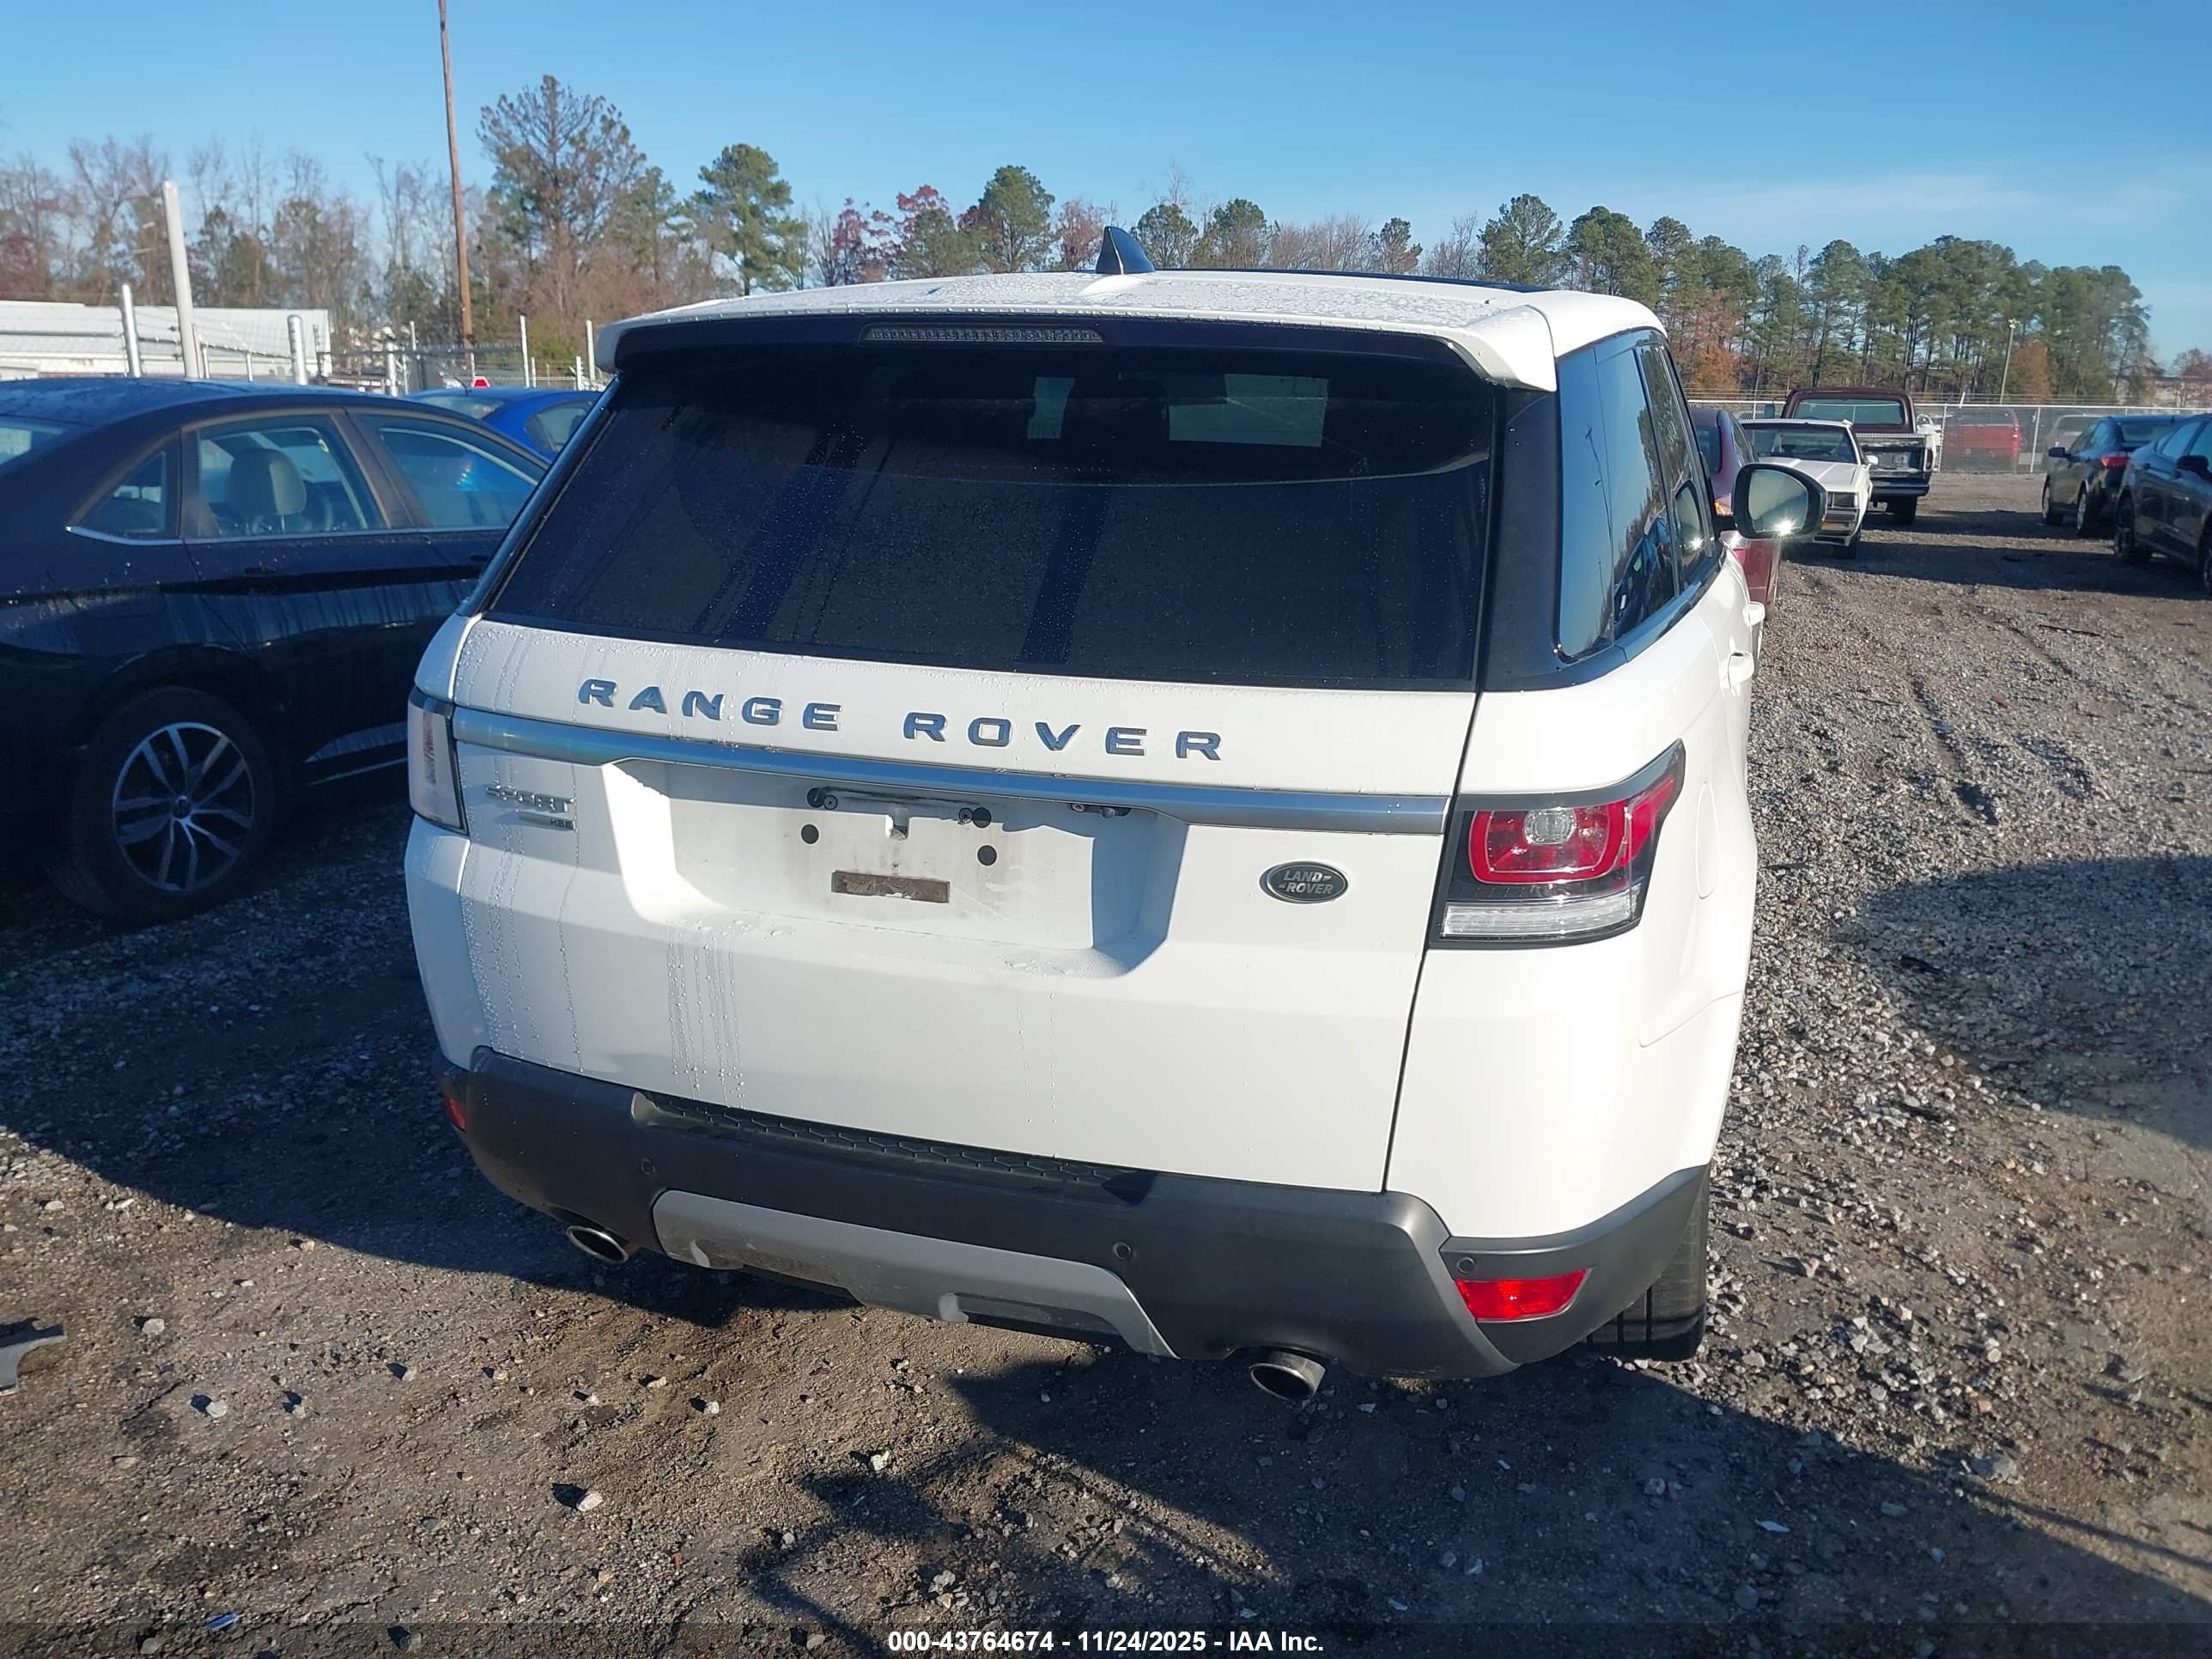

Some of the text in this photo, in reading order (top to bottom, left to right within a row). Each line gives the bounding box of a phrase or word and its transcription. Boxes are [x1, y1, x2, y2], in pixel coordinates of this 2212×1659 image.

[577, 678, 1222, 762] RANGE ROVER
[1283, 870, 1323, 883] LAND
[1285, 882, 1334, 894] ROVER
